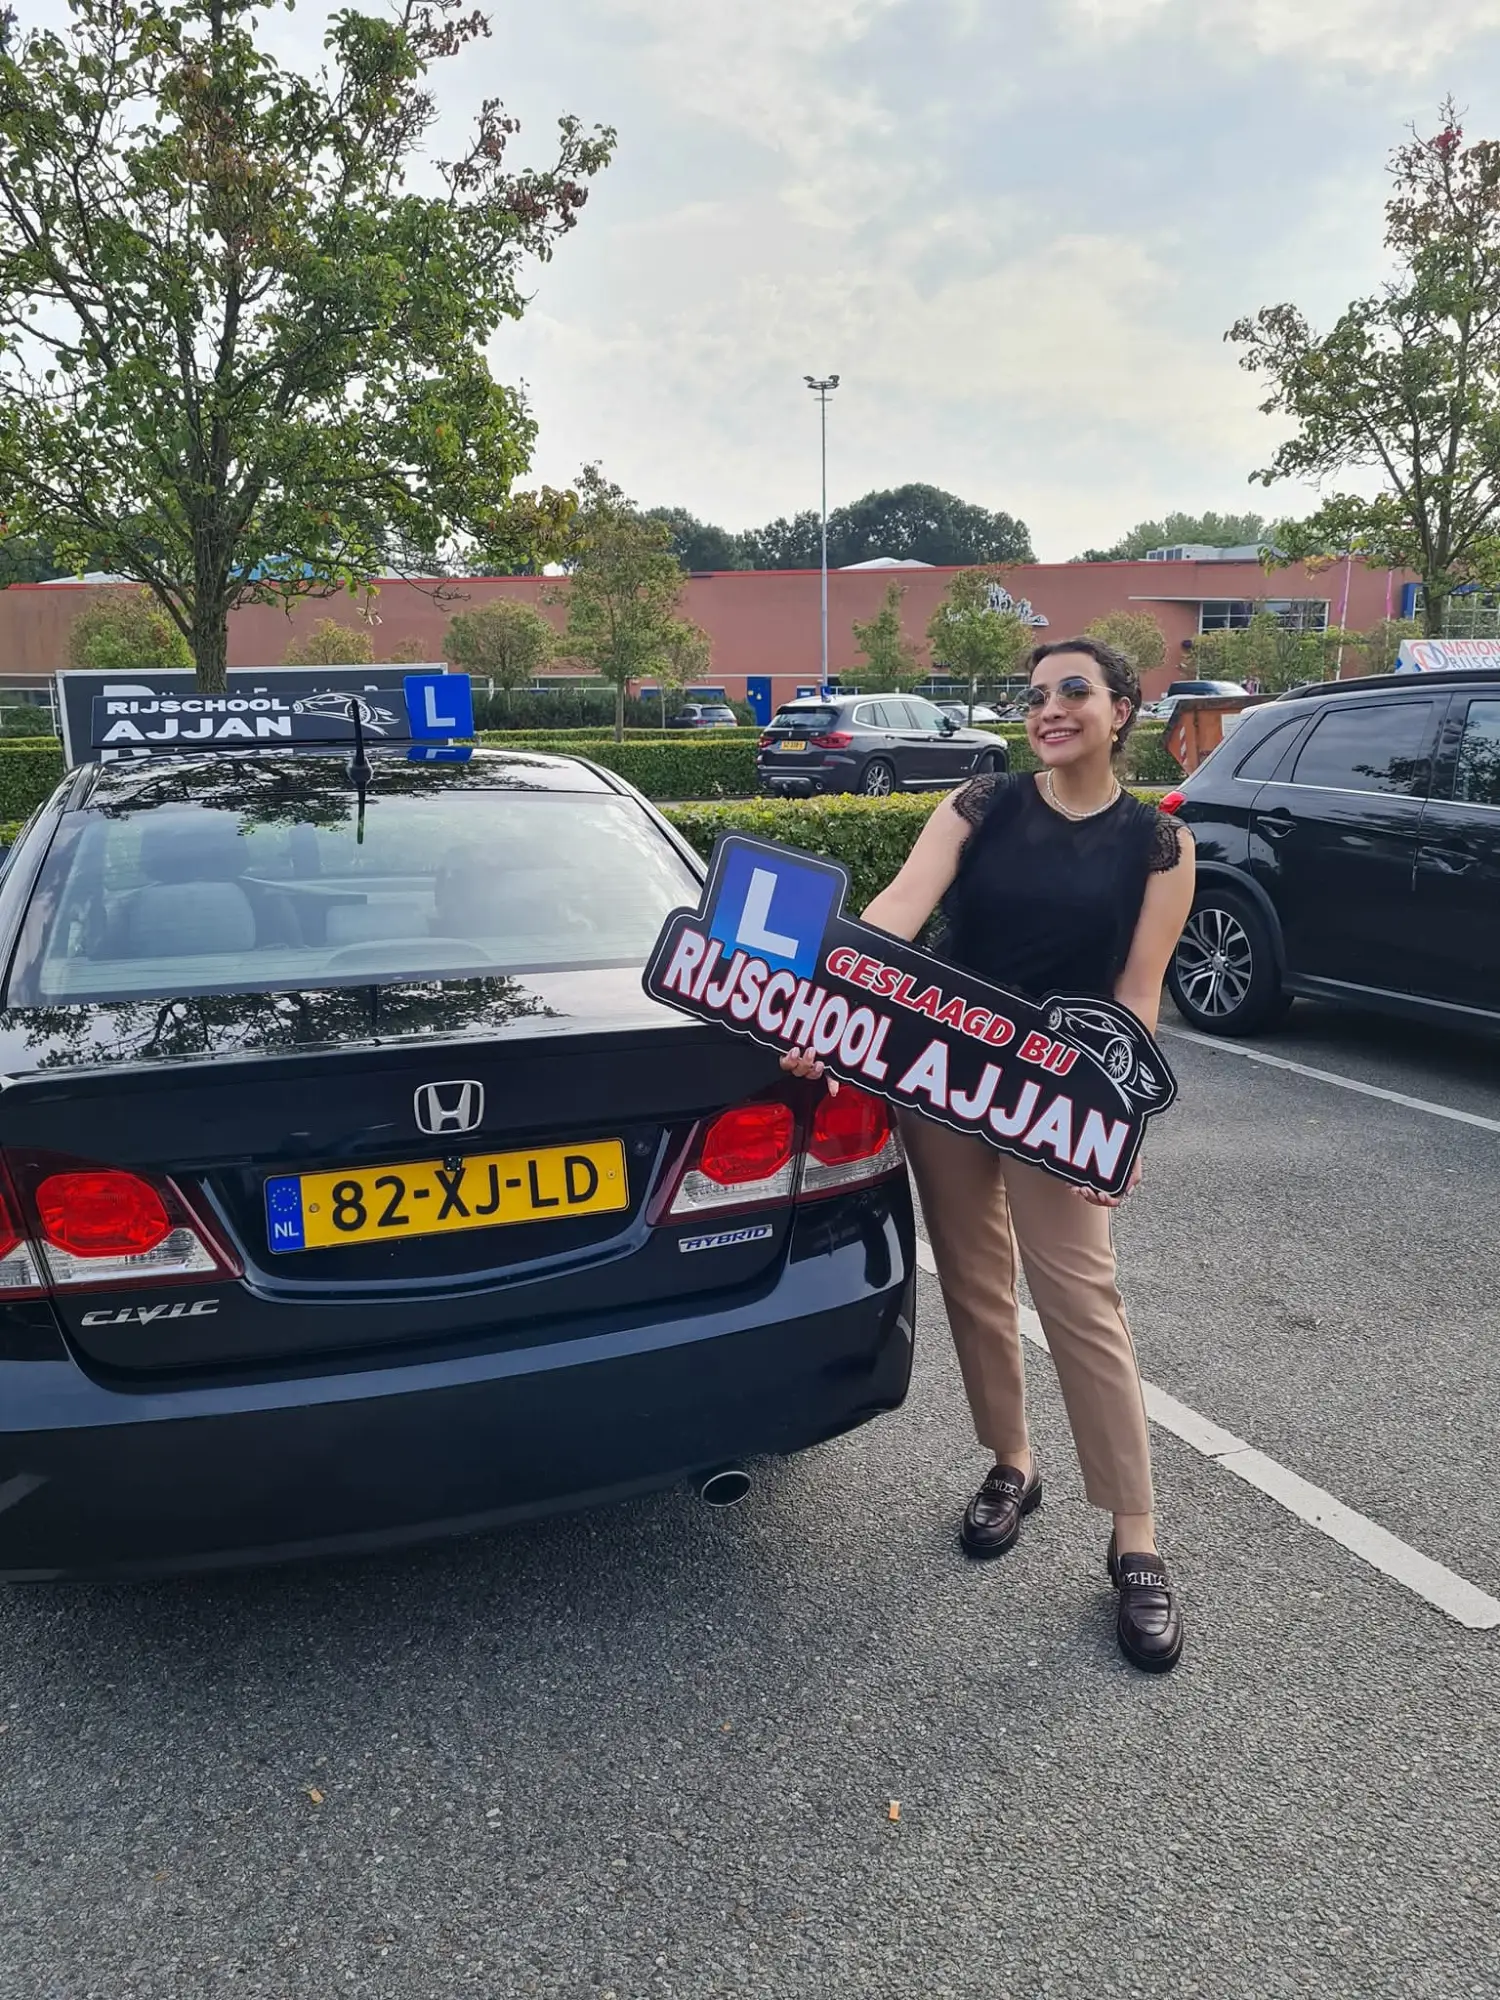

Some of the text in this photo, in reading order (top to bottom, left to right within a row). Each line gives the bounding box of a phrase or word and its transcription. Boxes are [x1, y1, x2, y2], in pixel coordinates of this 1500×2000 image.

[107, 698, 290, 715] RIJSCHOOL
[424, 686, 456, 727] L
[102, 716, 292, 742] AJJAN
[736, 867, 799, 960] L
[825, 946, 1081, 1077] GESLAAGD BIJ
[662, 927, 1130, 1181] RIJSCHOOL AJJAN
[331, 1155, 599, 1232] 82-XJ-LD
[274, 1221, 300, 1239] NL
[685, 1226, 769, 1250] HYBRID
[81, 1299, 220, 1326] CIVIC
